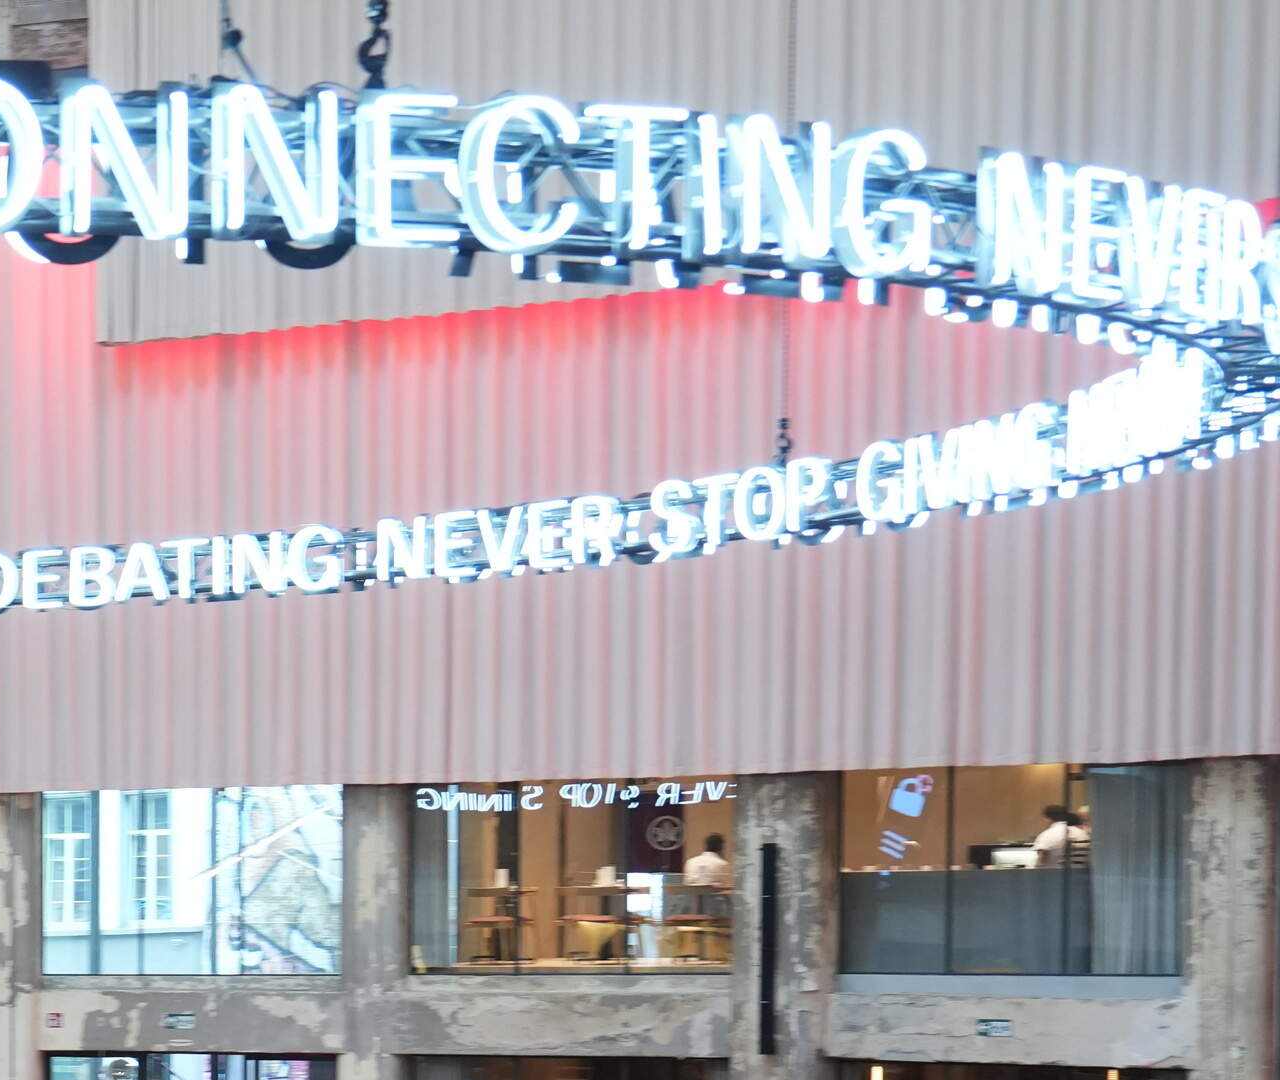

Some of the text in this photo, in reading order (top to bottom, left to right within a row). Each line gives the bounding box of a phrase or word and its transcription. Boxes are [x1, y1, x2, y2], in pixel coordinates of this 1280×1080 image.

[983, 151, 1264, 325] NEVER
[376, 496, 619, 581] NEVER
[650, 457, 831, 554] STOP
